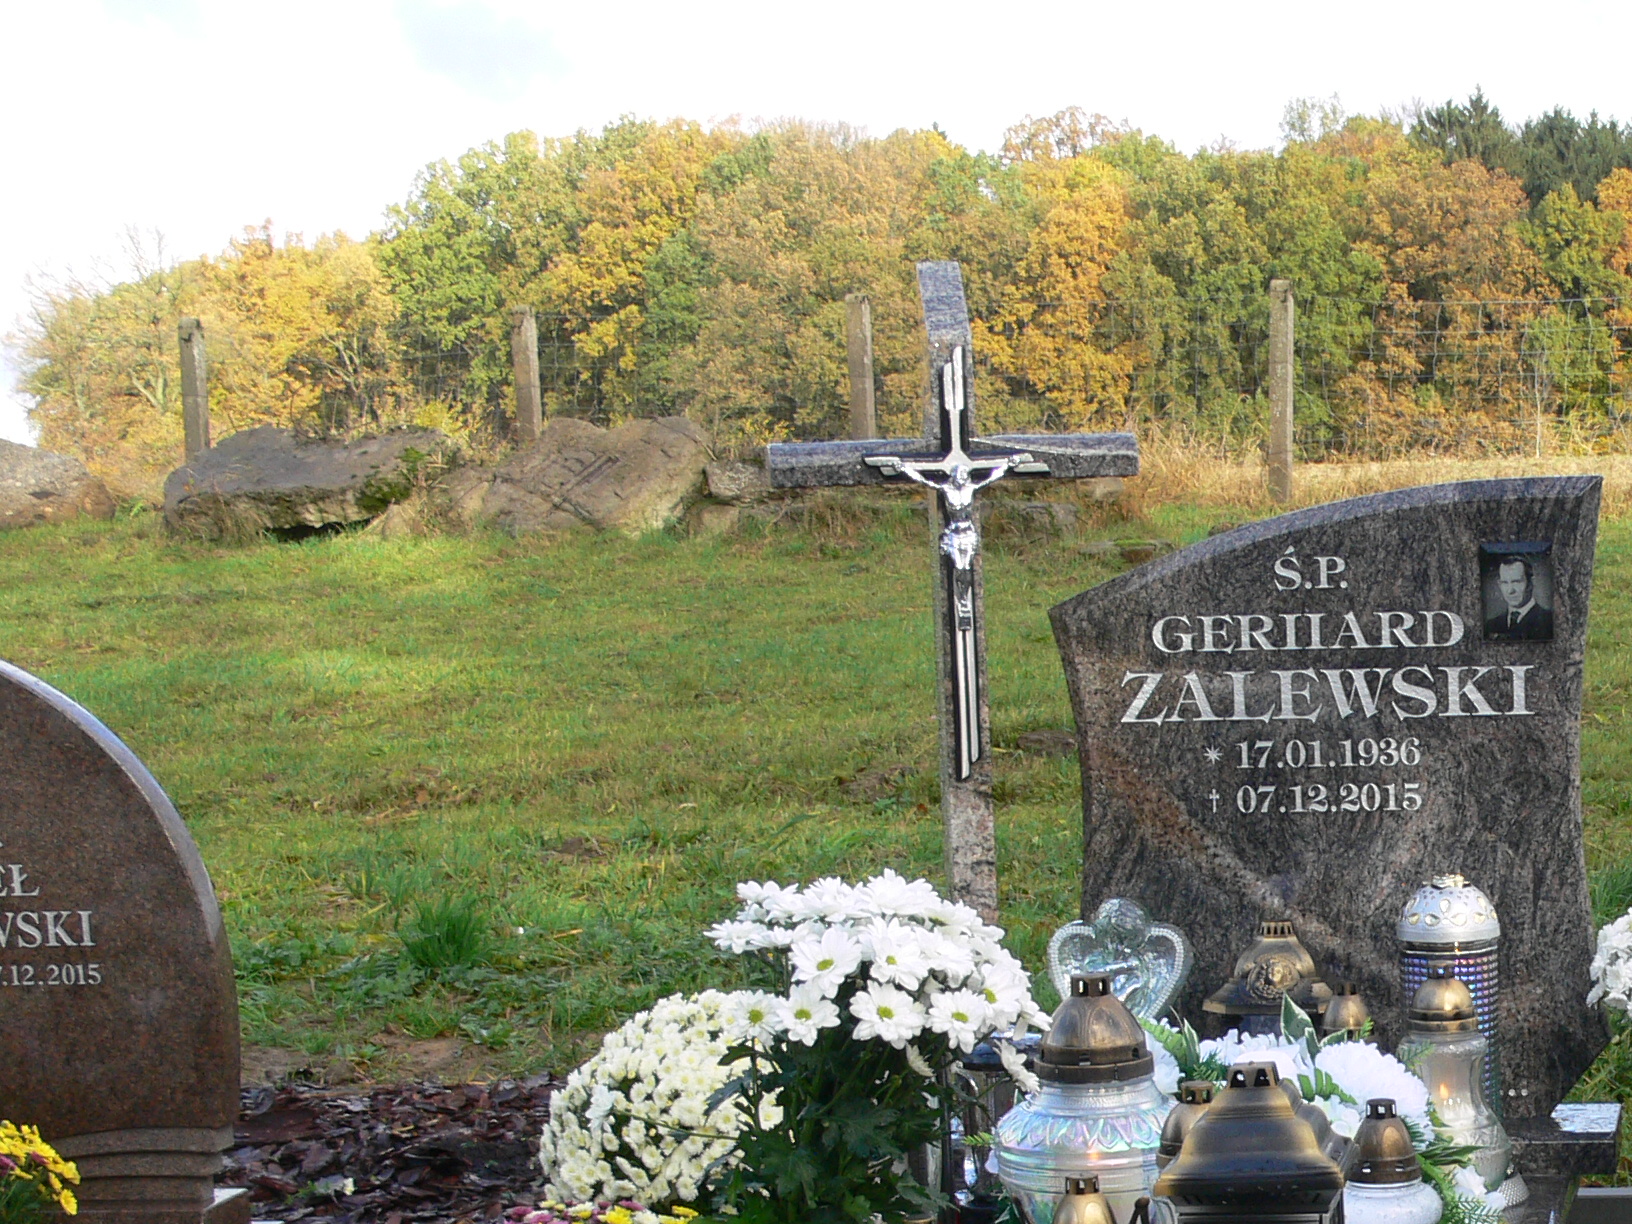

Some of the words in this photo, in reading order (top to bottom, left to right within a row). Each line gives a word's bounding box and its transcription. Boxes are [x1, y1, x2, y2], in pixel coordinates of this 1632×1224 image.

[1274, 548, 1348, 591] Ś.P.
[1151, 610, 1465, 654] GERHARD
[1121, 664, 1535, 727] ZALEWSKI
[1236, 738, 1421, 769] 17.01.1936
[1237, 782, 1422, 813] 07.12.2015
